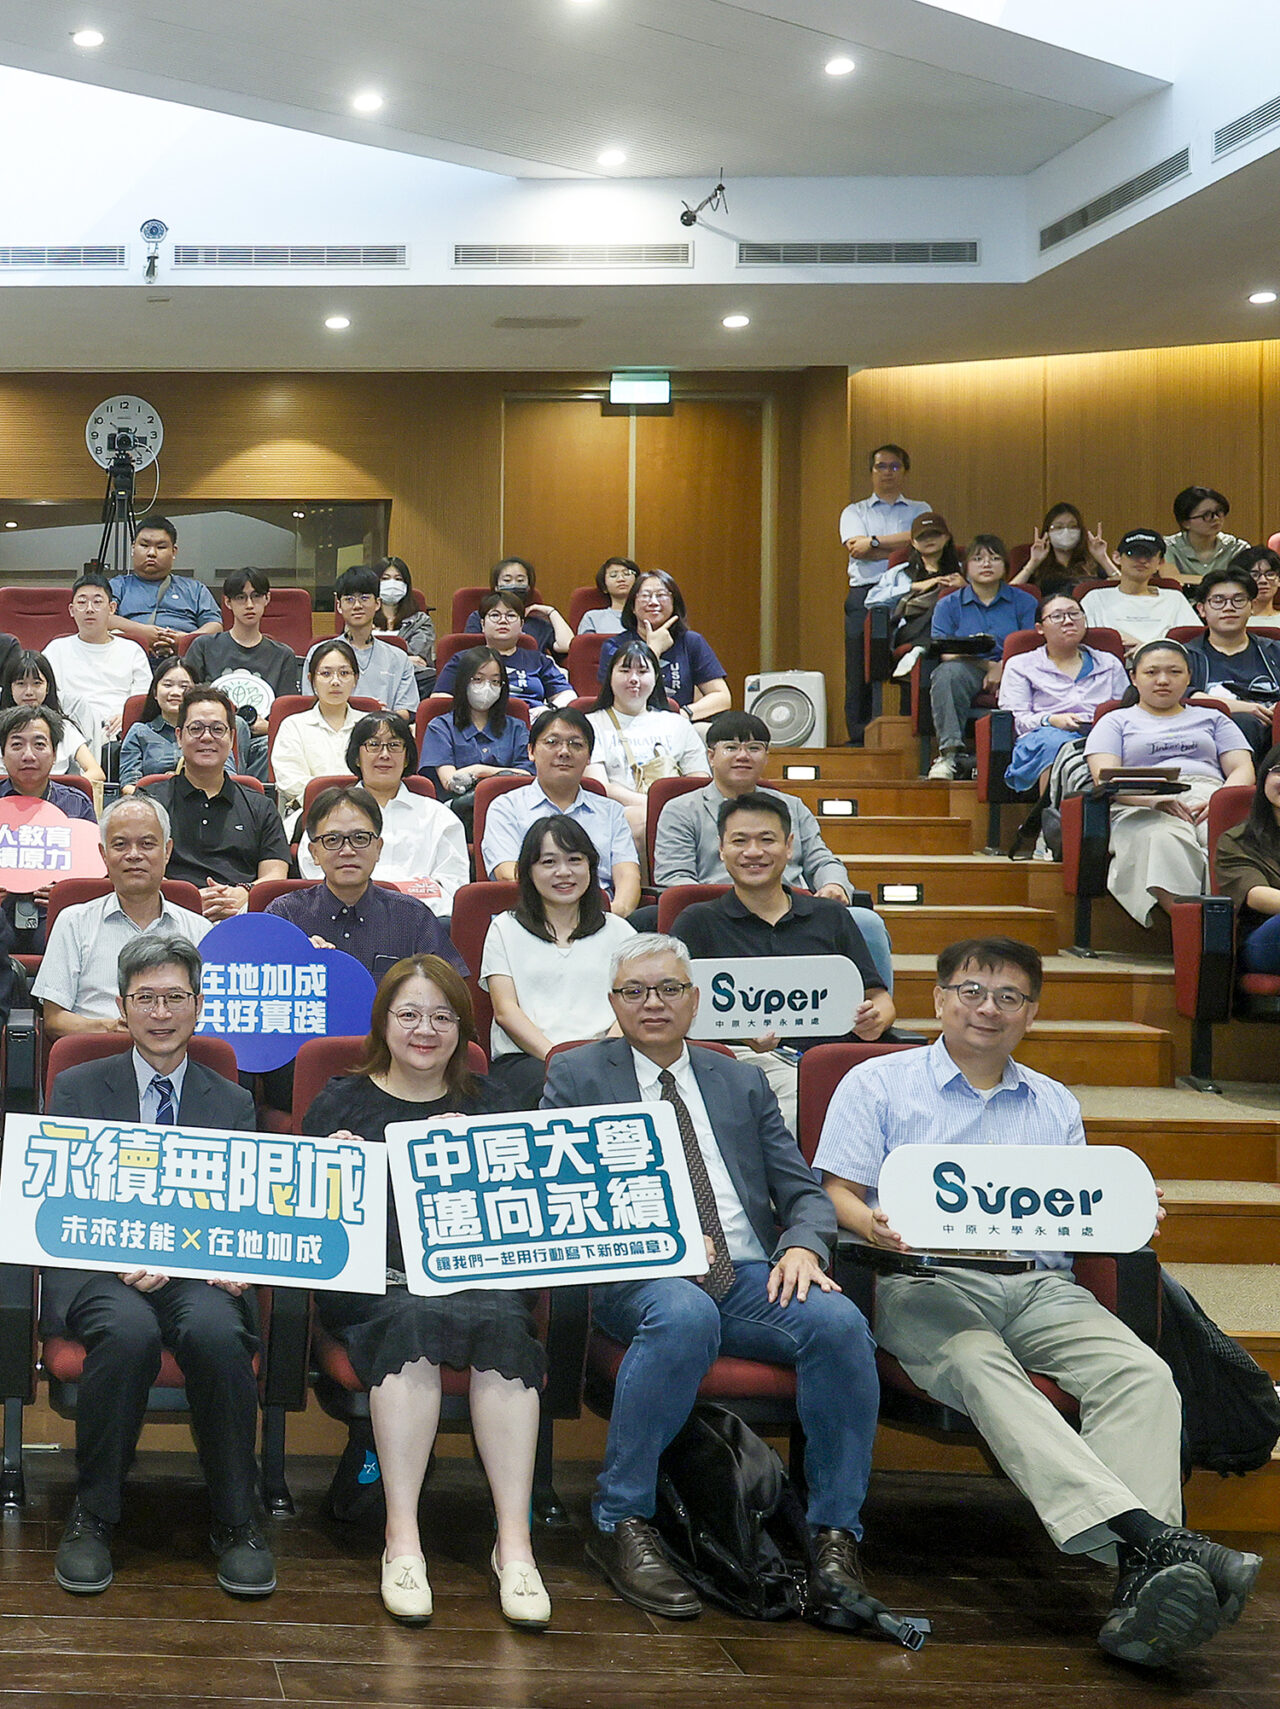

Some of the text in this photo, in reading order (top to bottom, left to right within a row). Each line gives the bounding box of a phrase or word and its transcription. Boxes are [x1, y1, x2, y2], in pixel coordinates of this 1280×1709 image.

[96, 446, 103, 454] 8
[150, 431, 157, 439] 3
[202, 962, 327, 997] 在地加成
[711, 972, 828, 1014] Super
[23, 1122, 365, 1225] 永續無限城
[413, 1118, 655, 1187] 中原大學
[421, 1175, 671, 1246] 邁向永續
[933, 1161, 1103, 1219] Super
[943, 1224, 1094, 1237] 中原大學永續處
